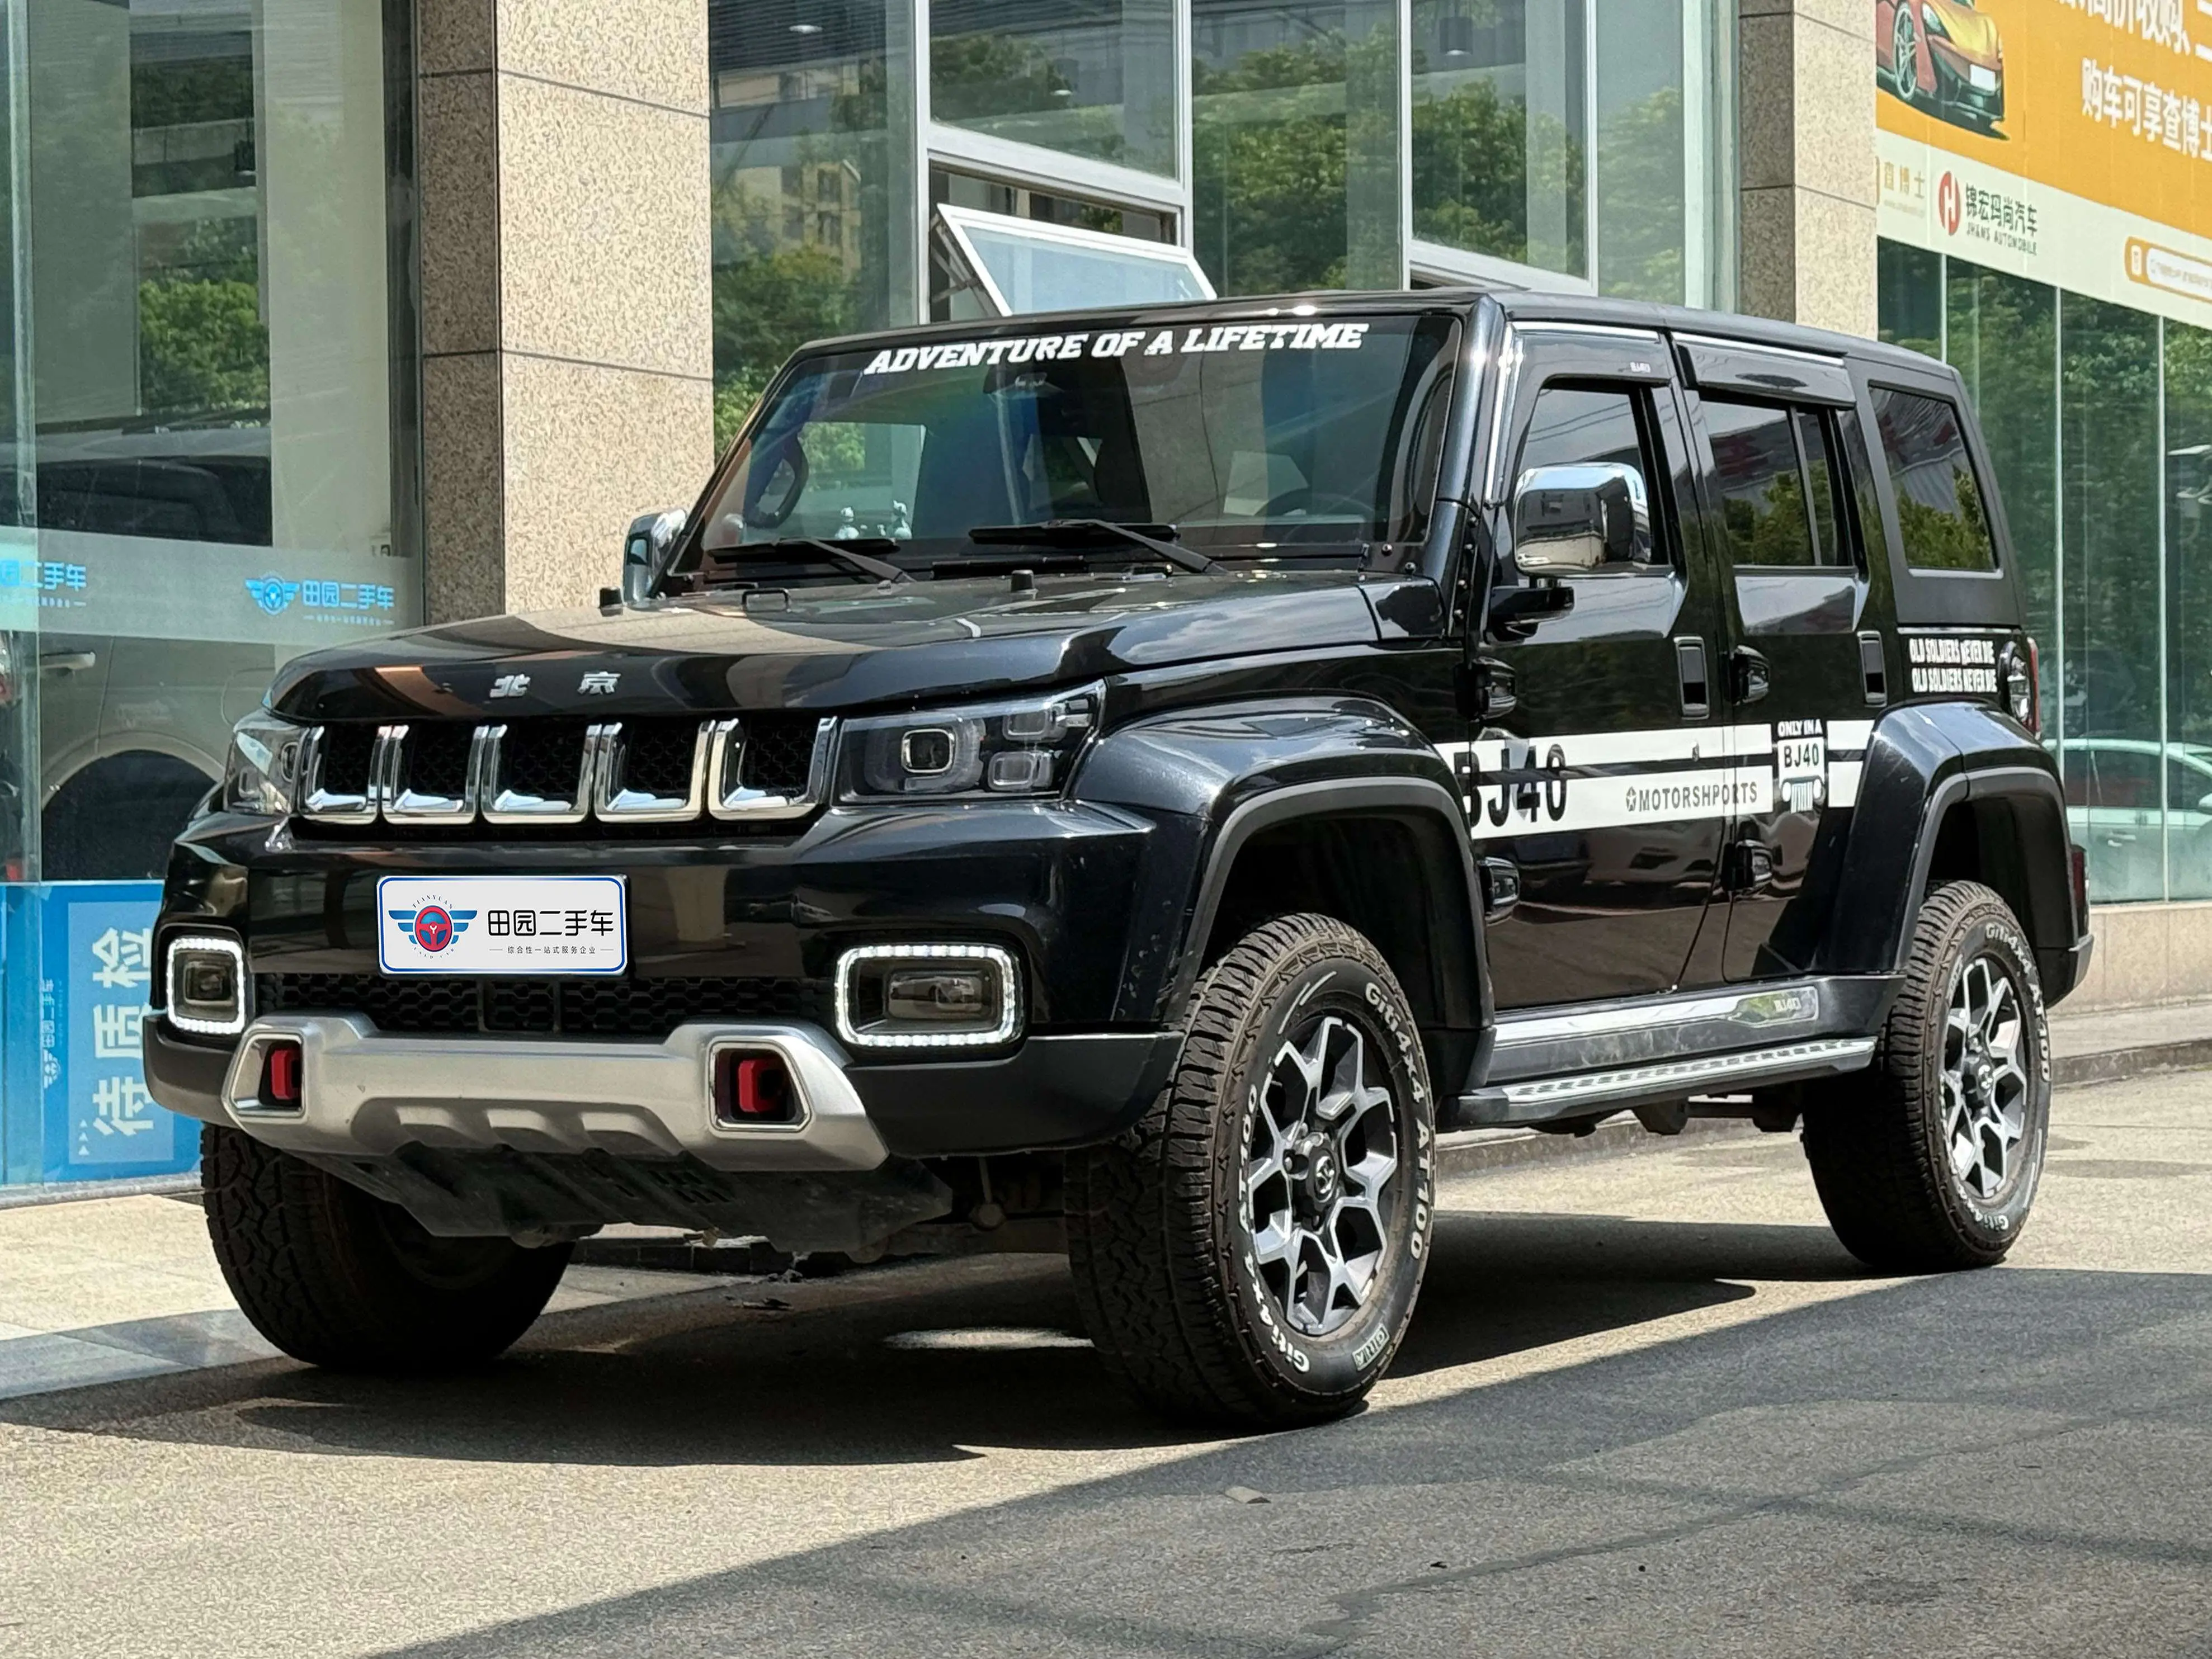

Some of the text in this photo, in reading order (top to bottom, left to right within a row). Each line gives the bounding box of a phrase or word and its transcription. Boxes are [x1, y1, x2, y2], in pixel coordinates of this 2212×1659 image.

[864, 323, 1369, 375] ADVENTURE OF A LIFETIME
[303, 580, 394, 611] 田园二手车
[489, 672, 621, 698] 北京
[1778, 719, 1823, 737] ONLY IN A
[1784, 743, 1819, 769] BJ40
[1454, 744, 1567, 828] BJ40
[1639, 781, 1757, 812] MOTORSHPORTS
[488, 909, 614, 937] 田园二手车
[507, 945, 596, 954] 综合性一站式服务企业
[1985, 922, 2053, 1082] Giti4x4 AT100
[92, 928, 154, 1136] 待质检
[1365, 982, 1430, 1260] Giti4x4 AT100
[1238, 1083, 1310, 1373] Giti4x4 AT100
